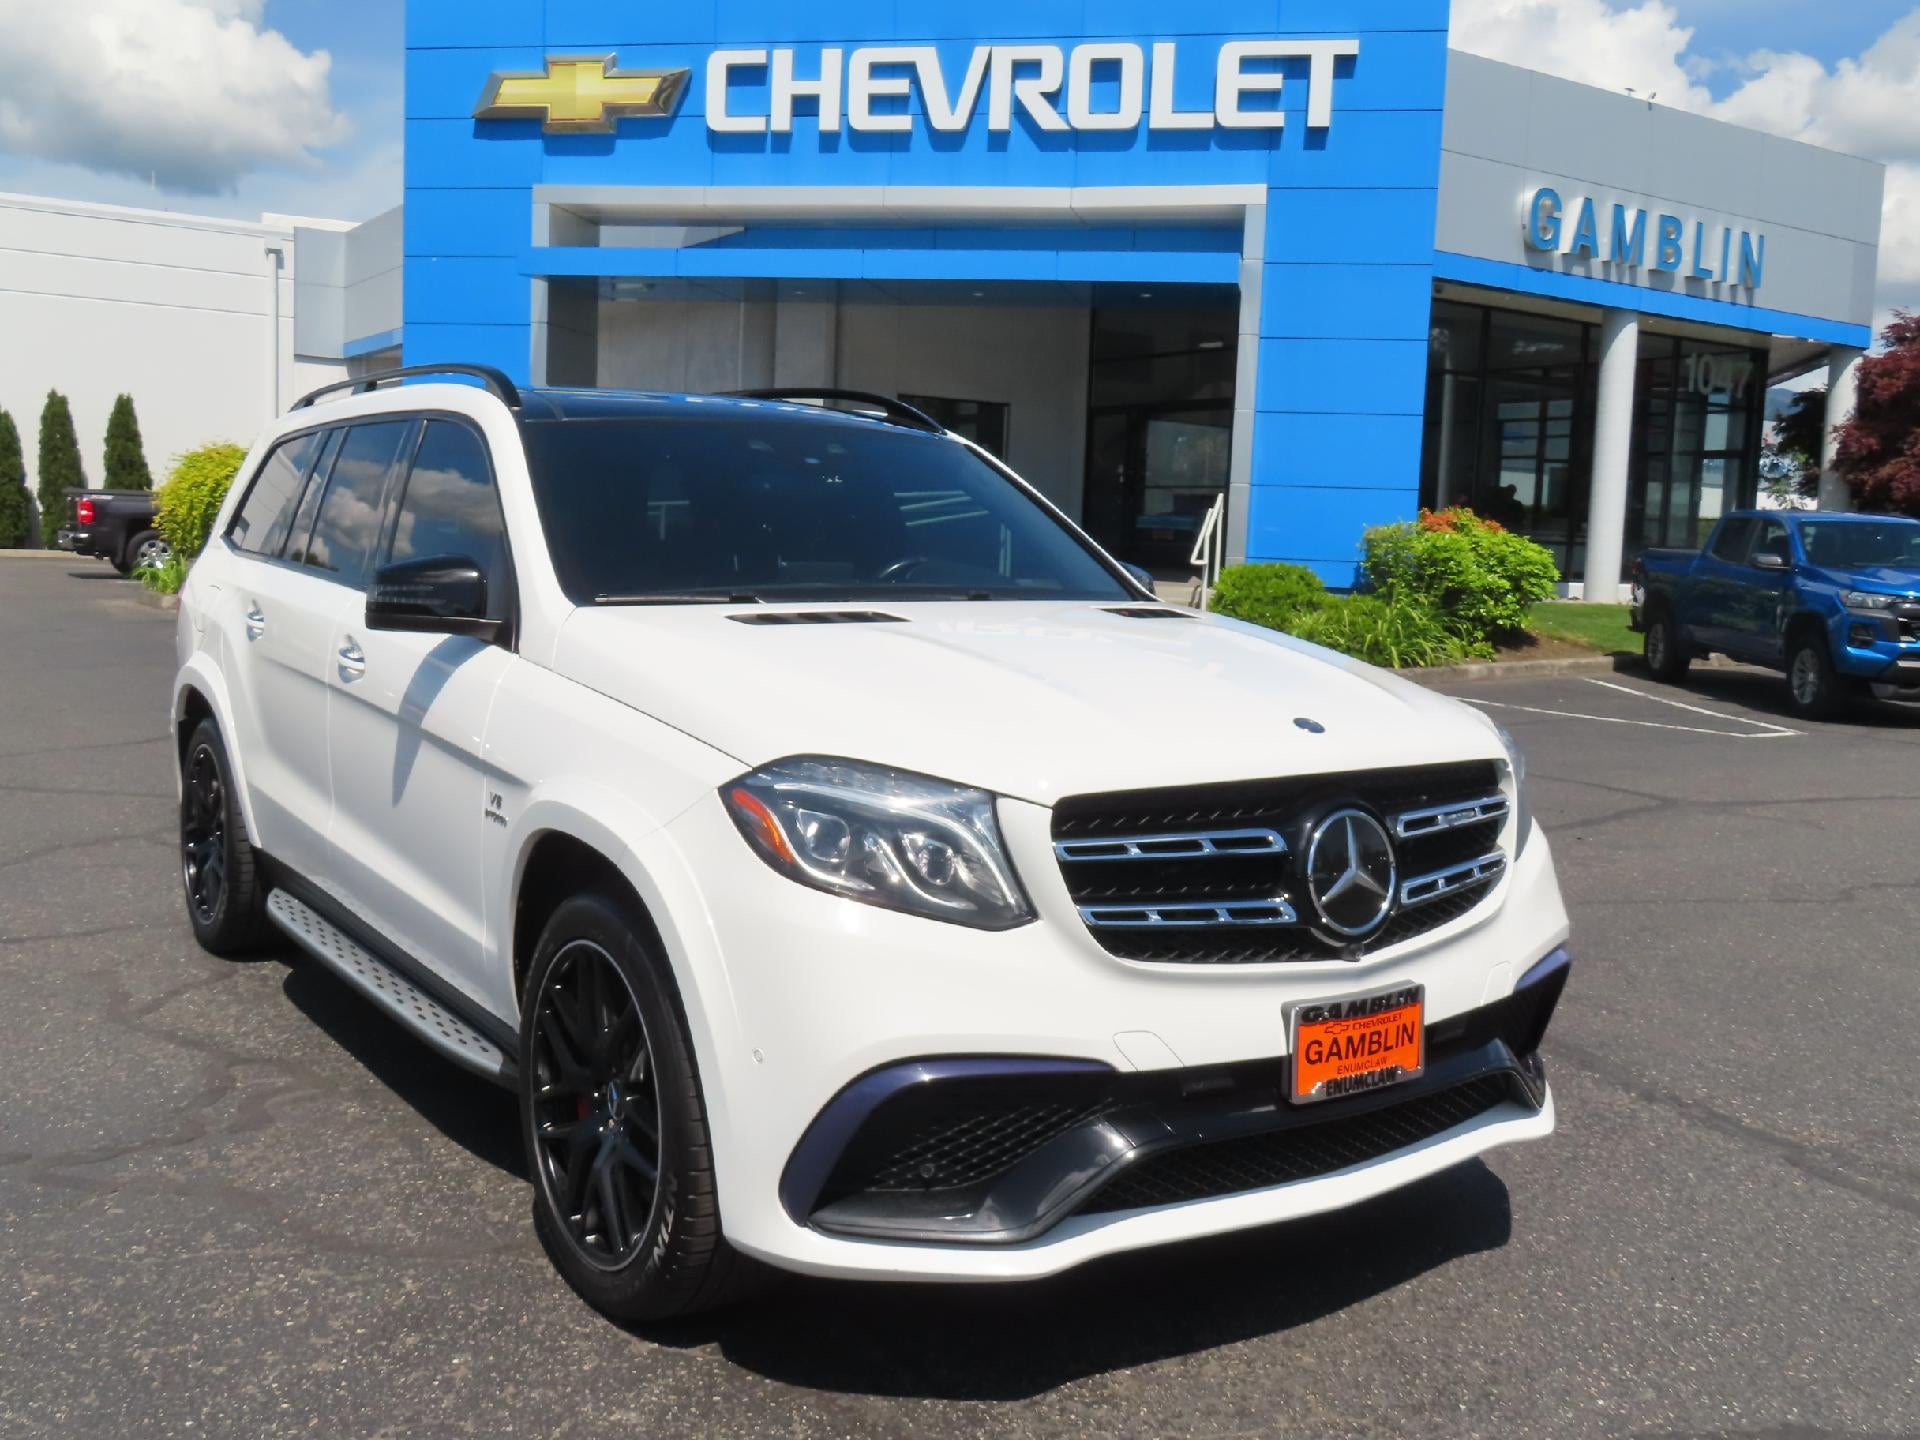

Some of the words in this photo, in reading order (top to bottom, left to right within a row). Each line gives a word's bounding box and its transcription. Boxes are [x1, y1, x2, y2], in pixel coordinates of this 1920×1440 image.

[706, 40, 1360, 134] CHEVROLET
[1529, 187, 1765, 289] GAMBLIN
[1352, 1014, 1402, 1030] CHEVROLET
[1305, 1021, 1415, 1065] GAMBLIN
[1325, 1065, 1398, 1097] ENUMCLAW
[1337, 1056, 1388, 1074] ENUMCLAW
